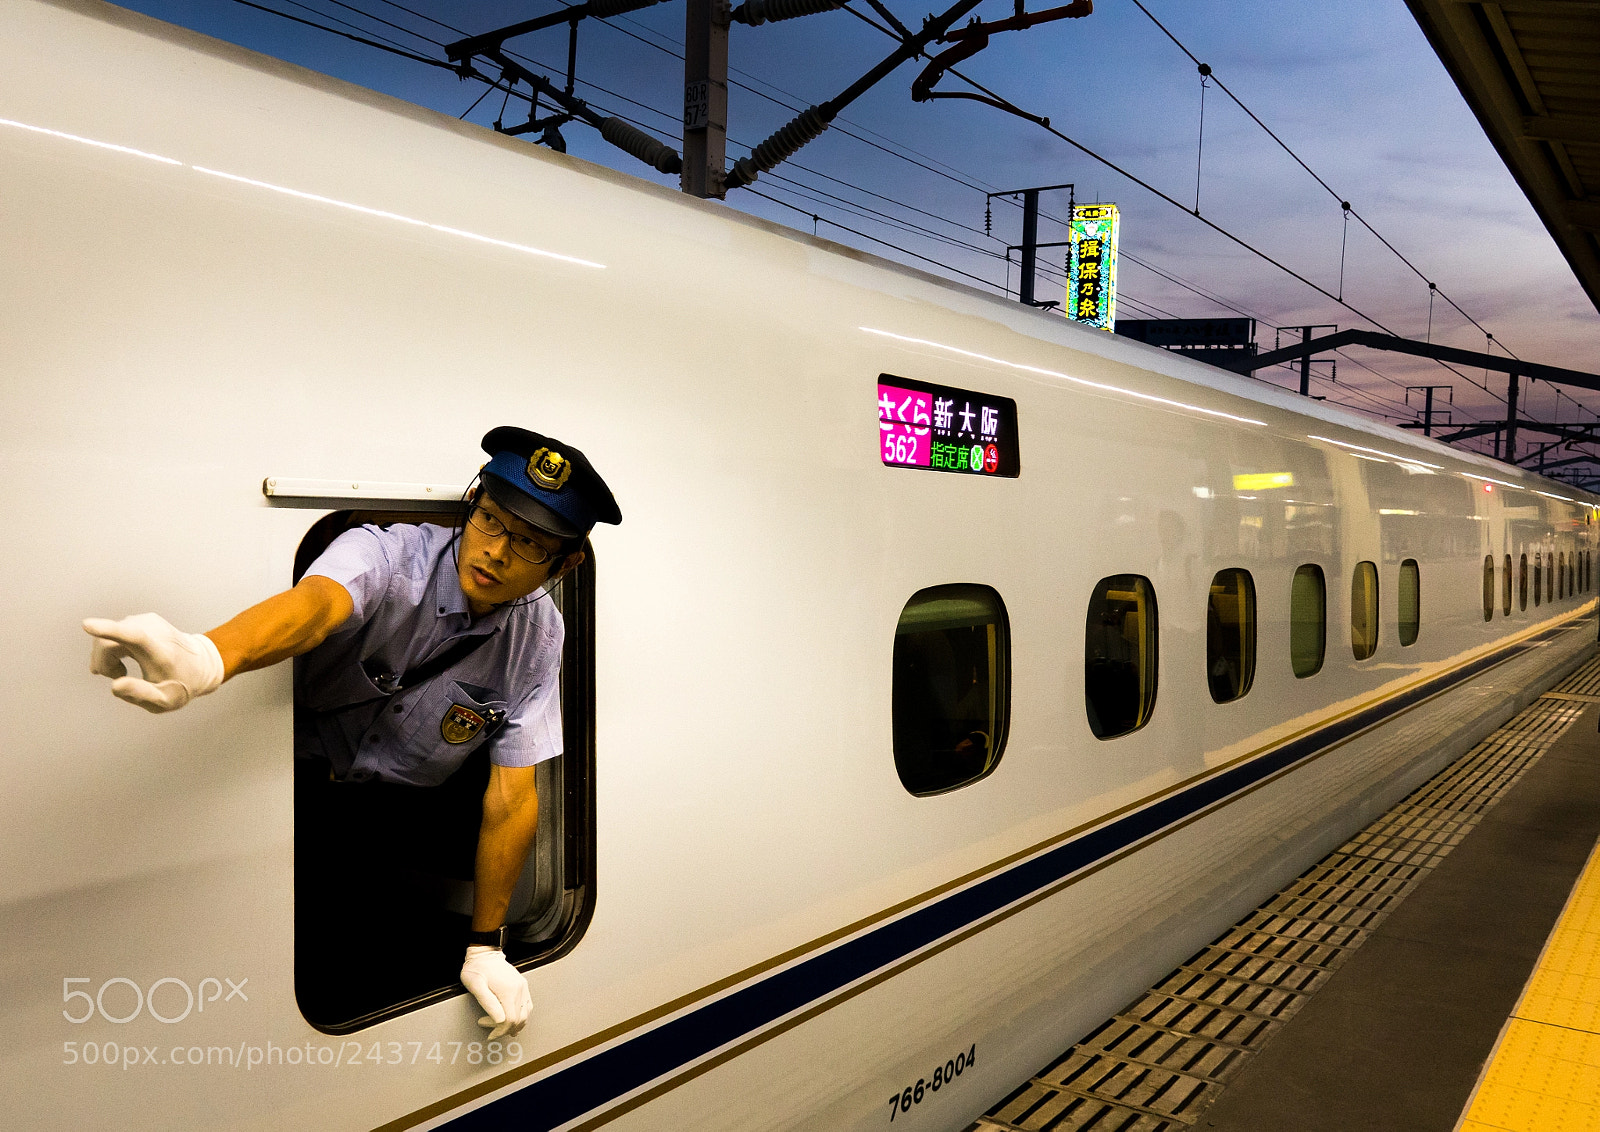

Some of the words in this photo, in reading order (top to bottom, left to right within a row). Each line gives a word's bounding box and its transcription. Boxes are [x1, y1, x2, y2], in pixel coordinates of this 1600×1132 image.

[878, 392, 930, 436] さくら
[933, 396, 999, 442] 新大阪
[884, 433, 917, 463] 562
[930, 441, 970, 469] 指定席
[888, 1043, 976, 1123] 766-8004
